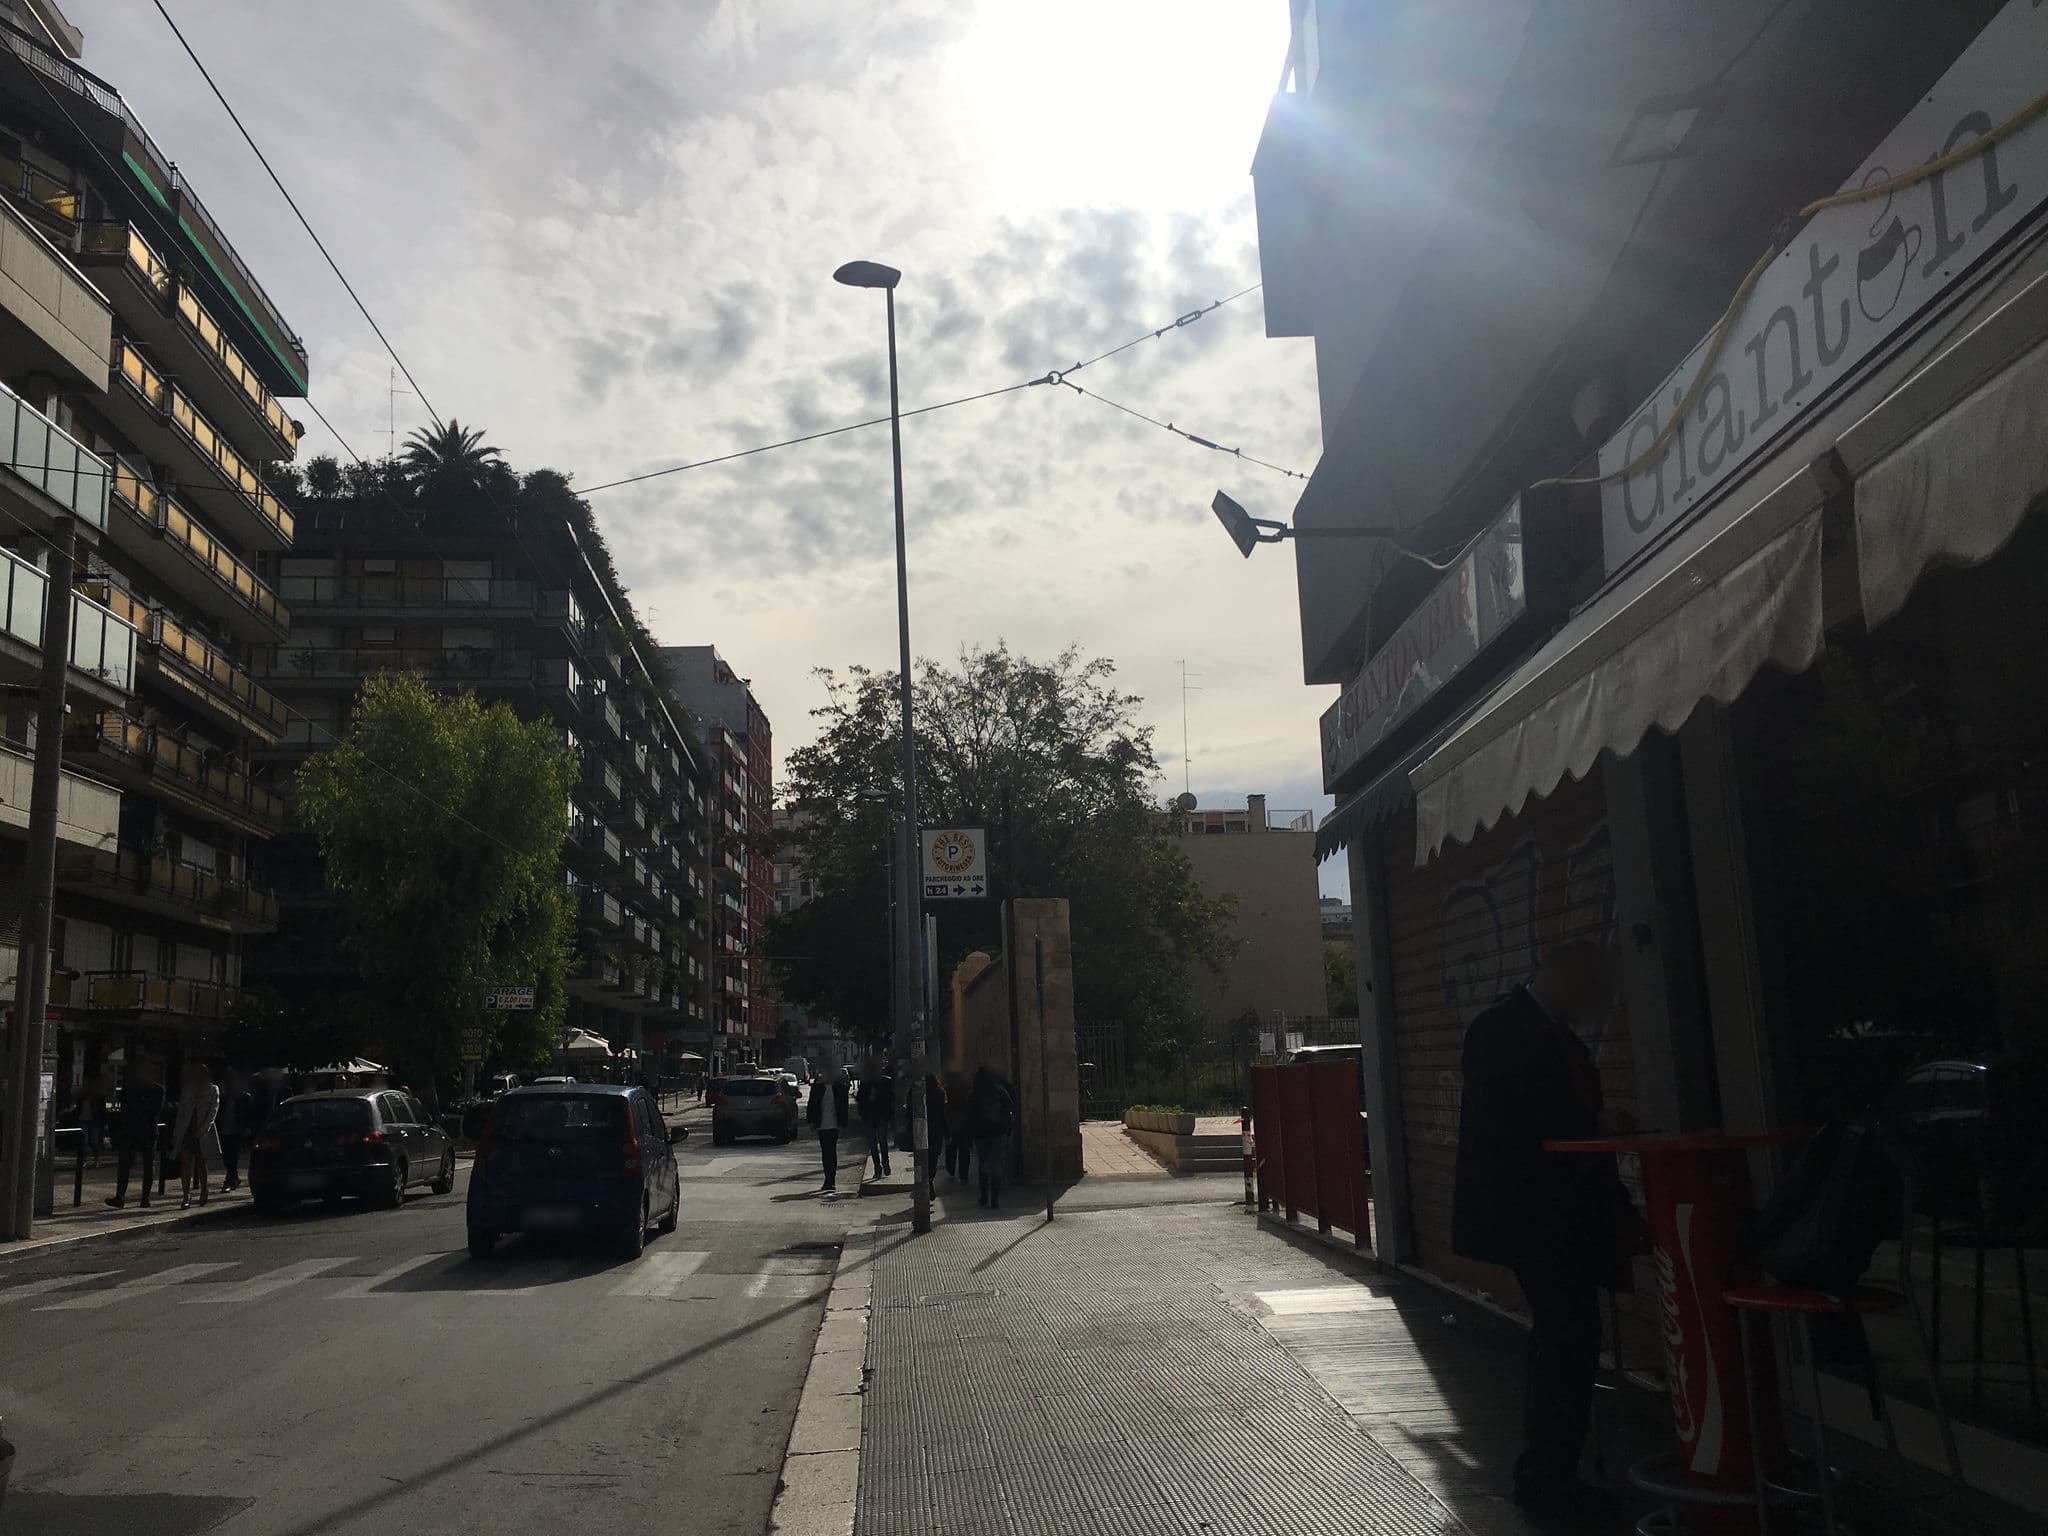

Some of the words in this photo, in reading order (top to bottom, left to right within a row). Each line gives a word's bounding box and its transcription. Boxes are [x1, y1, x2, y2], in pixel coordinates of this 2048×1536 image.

[934, 834, 950, 850] THE
[953, 833, 972, 849] BEST
[948, 845, 958, 859] P
